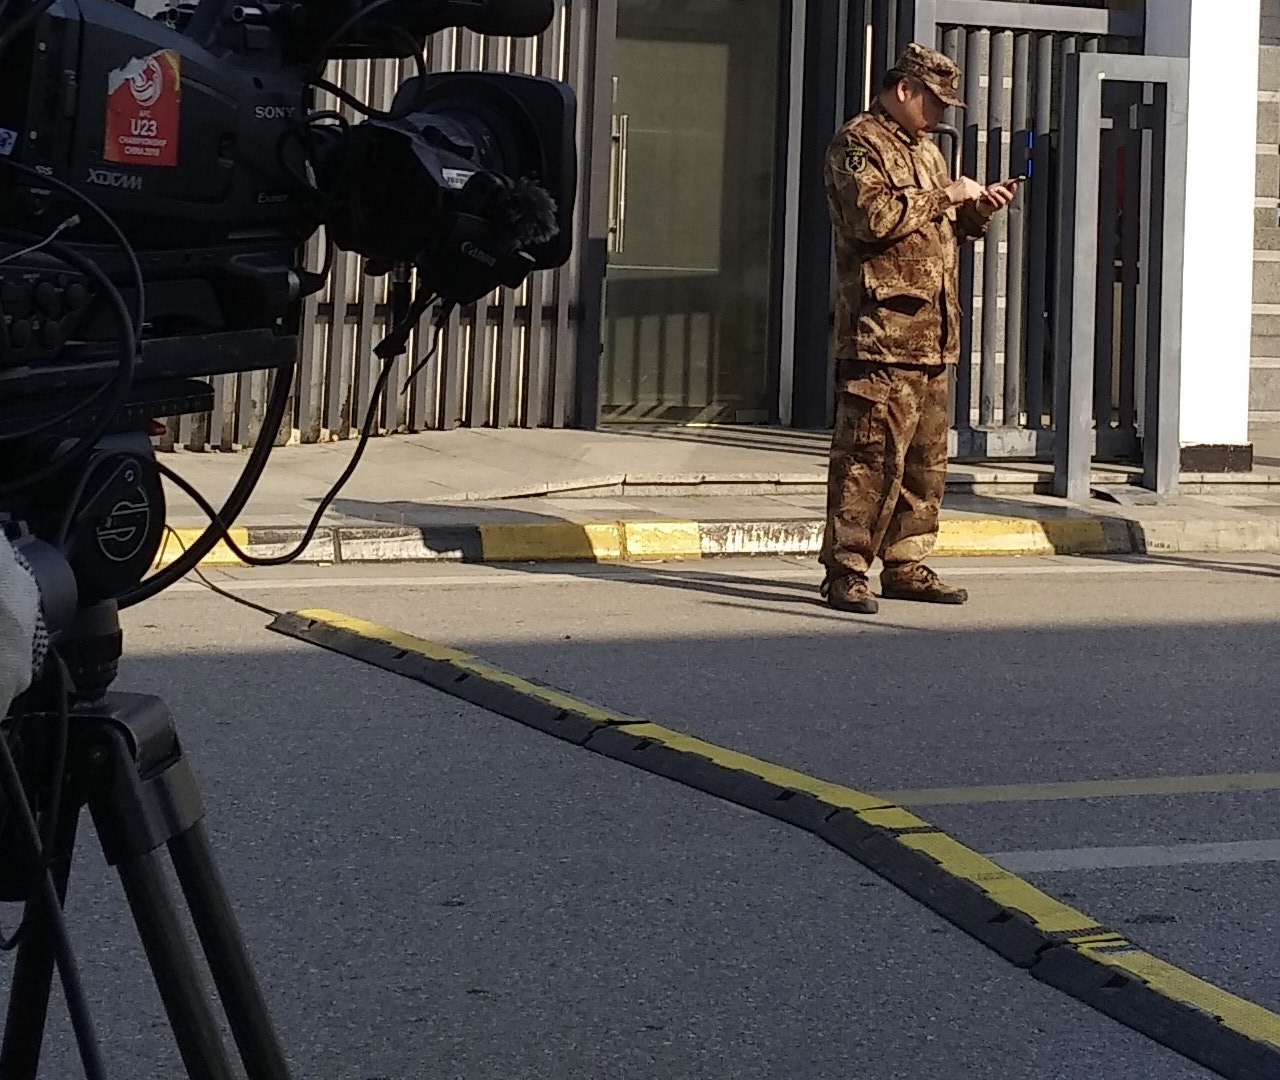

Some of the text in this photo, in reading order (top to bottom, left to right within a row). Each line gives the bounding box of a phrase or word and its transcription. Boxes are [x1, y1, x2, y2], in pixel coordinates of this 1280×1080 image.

[254, 105, 296, 119] SONY
[129, 118, 157, 137] U23
[86, 167, 144, 191] XDCAM
[460, 240, 498, 268] Canon
